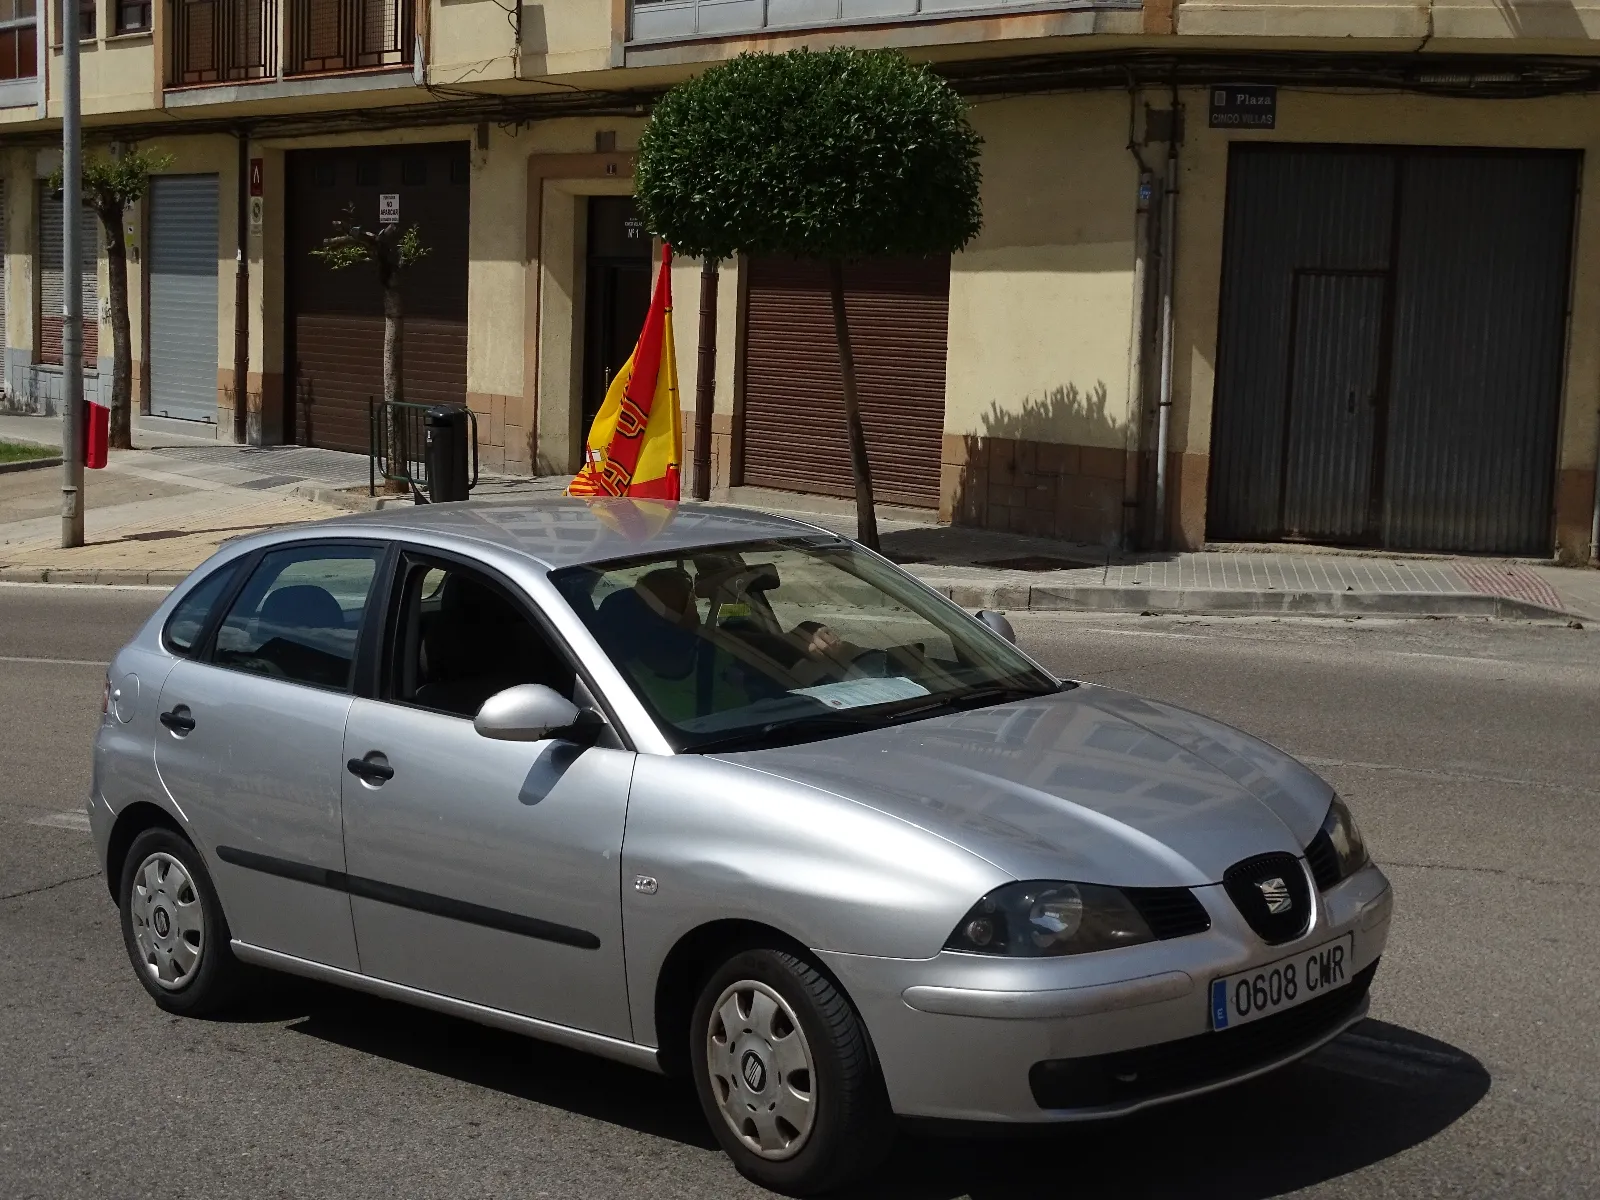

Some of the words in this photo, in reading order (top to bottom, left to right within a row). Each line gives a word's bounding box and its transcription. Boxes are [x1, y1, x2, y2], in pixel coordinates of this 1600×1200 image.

[1236, 94, 1272, 105] Plaza
[1211, 113, 1240, 124] CINCO
[1241, 113, 1273, 125] VILLAS
[1235, 963, 1297, 1016] 0608
[1306, 945, 1344, 991] CMR
